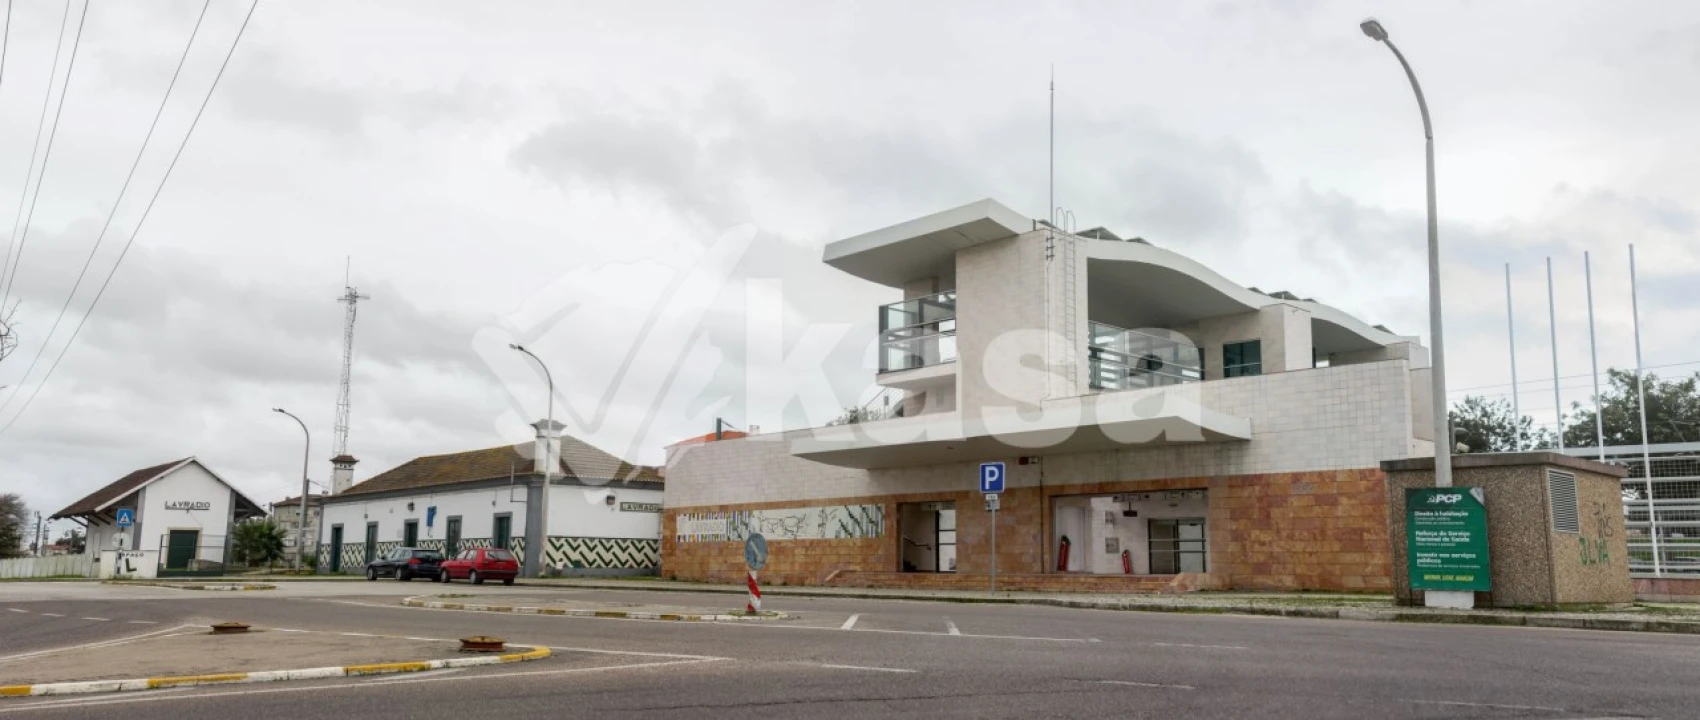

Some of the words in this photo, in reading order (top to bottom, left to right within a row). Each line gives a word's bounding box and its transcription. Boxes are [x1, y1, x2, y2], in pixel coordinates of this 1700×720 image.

[985, 466, 999, 489] P
[1436, 494, 1462, 503] PCP
[165, 501, 210, 509] LAVRADIO
